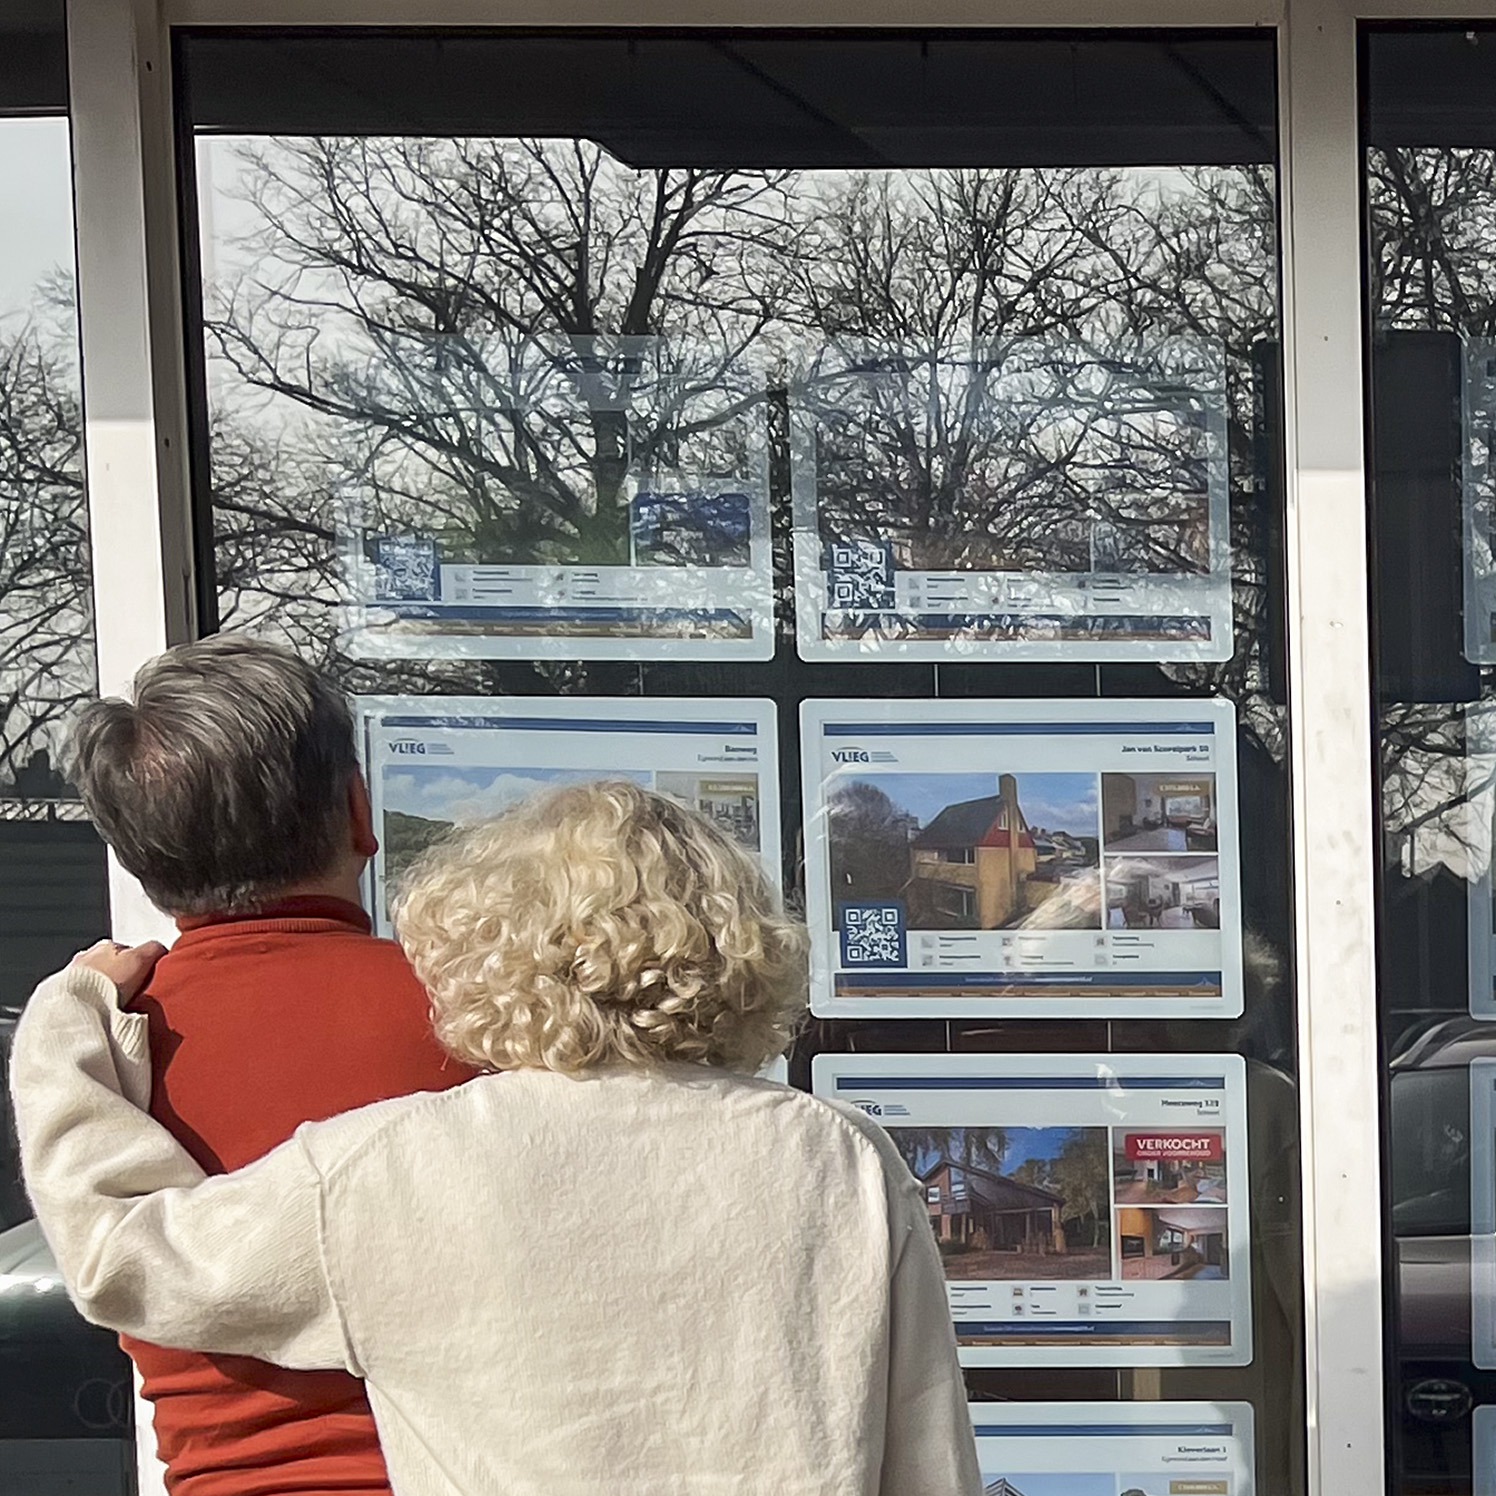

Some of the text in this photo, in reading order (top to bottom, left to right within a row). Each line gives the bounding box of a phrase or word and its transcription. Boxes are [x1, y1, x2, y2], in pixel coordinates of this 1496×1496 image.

[389, 742, 426, 754] VLIEG
[832, 751, 869, 763] VLIEG
[1136, 1138, 1210, 1150] VERKOCHT
